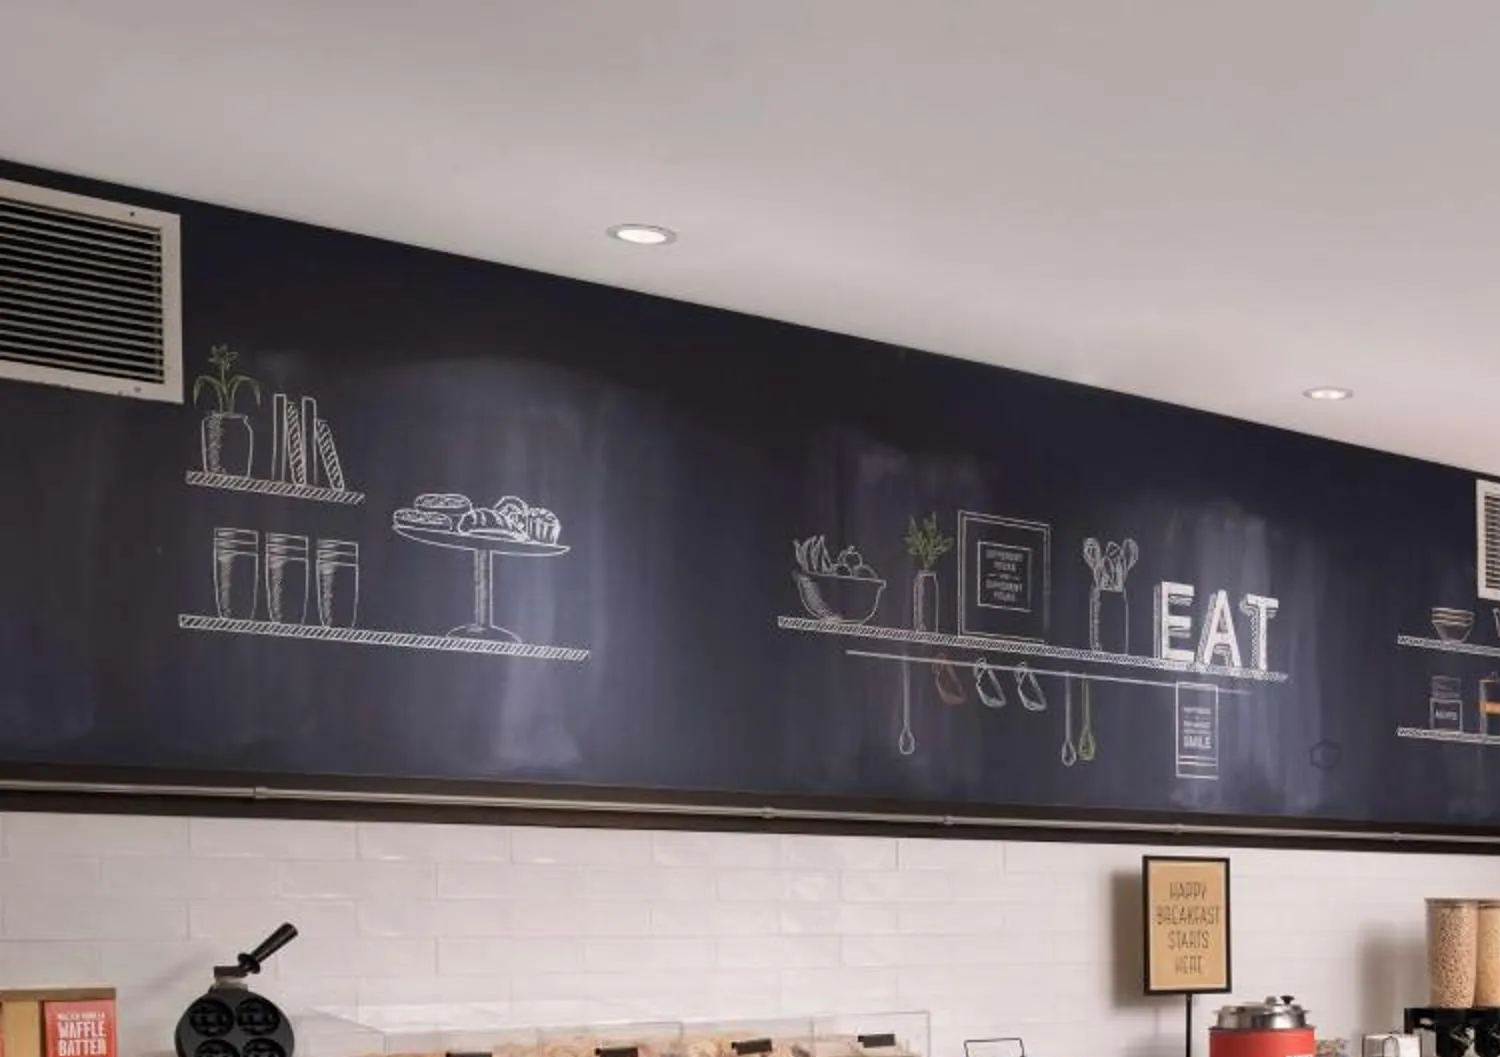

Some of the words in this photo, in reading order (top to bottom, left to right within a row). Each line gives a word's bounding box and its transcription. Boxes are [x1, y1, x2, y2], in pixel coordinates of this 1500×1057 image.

[1154, 580, 1279, 672] EAT
[1168, 881, 1207, 899] HAPPY
[1156, 904, 1219, 925] BREAKFAST
[1167, 930, 1209, 950] STARTS
[58, 1020, 107, 1039] WAFFLE
[58, 1038, 107, 1057] BATTER
